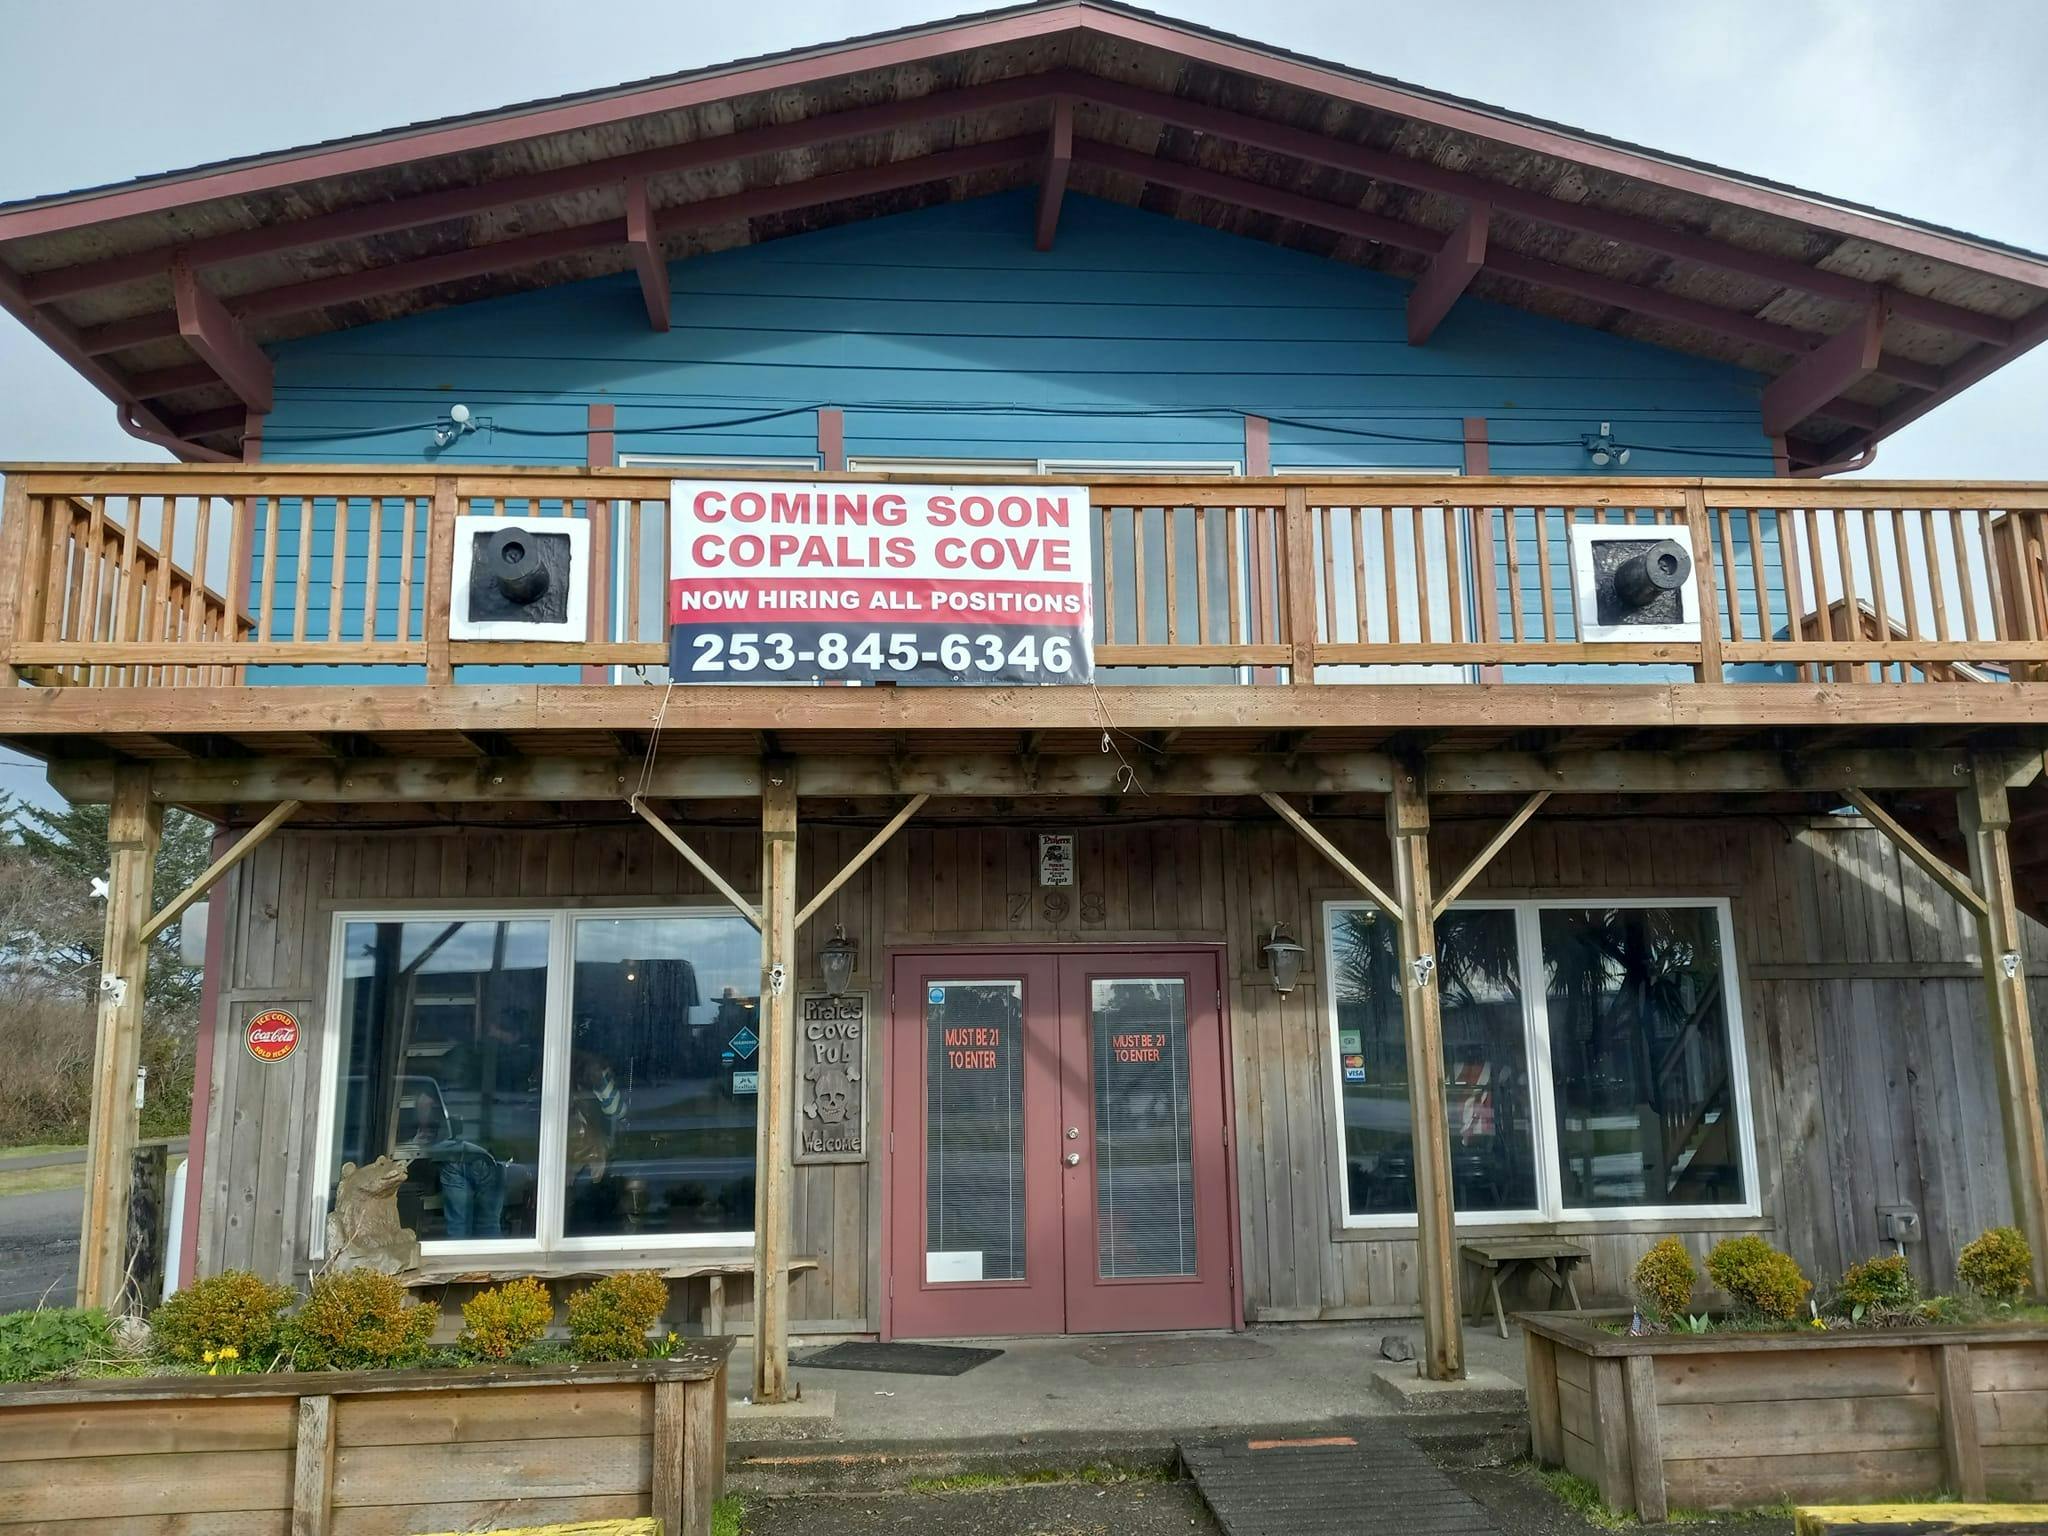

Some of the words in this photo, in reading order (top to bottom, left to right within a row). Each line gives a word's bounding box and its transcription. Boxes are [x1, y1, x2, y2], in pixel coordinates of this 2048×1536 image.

[693, 491, 908, 527] COMING
[926, 495, 1070, 528] SOON
[691, 534, 916, 568] COPALIS
[934, 538, 1071, 572] COVE
[681, 590, 749, 611] NOW
[759, 589, 861, 611] HIRING
[869, 591, 922, 611] ALL
[932, 591, 1081, 613] POSITIONS
[691, 632, 1073, 673] 253-845-6346
[257, 1014, 271, 1025] ICE
[271, 1013, 291, 1025] COLD
[249, 1027, 296, 1044] Coca-Cola
[945, 1028, 974, 1046] MUST
[975, 1028, 988, 1046] BE
[989, 1028, 999, 1046] 21
[1112, 1034, 1140, 1048] MUST
[1141, 1034, 1153, 1047] BE
[1156, 1033, 1166, 1047] 21
[254, 1045, 272, 1058] SOLD
[272, 1044, 291, 1058] HERE
[948, 1050, 964, 1069] TO
[965, 1050, 997, 1069] ENTER
[1115, 1049, 1129, 1062] TO
[1130, 1048, 1160, 1062] ENTER
